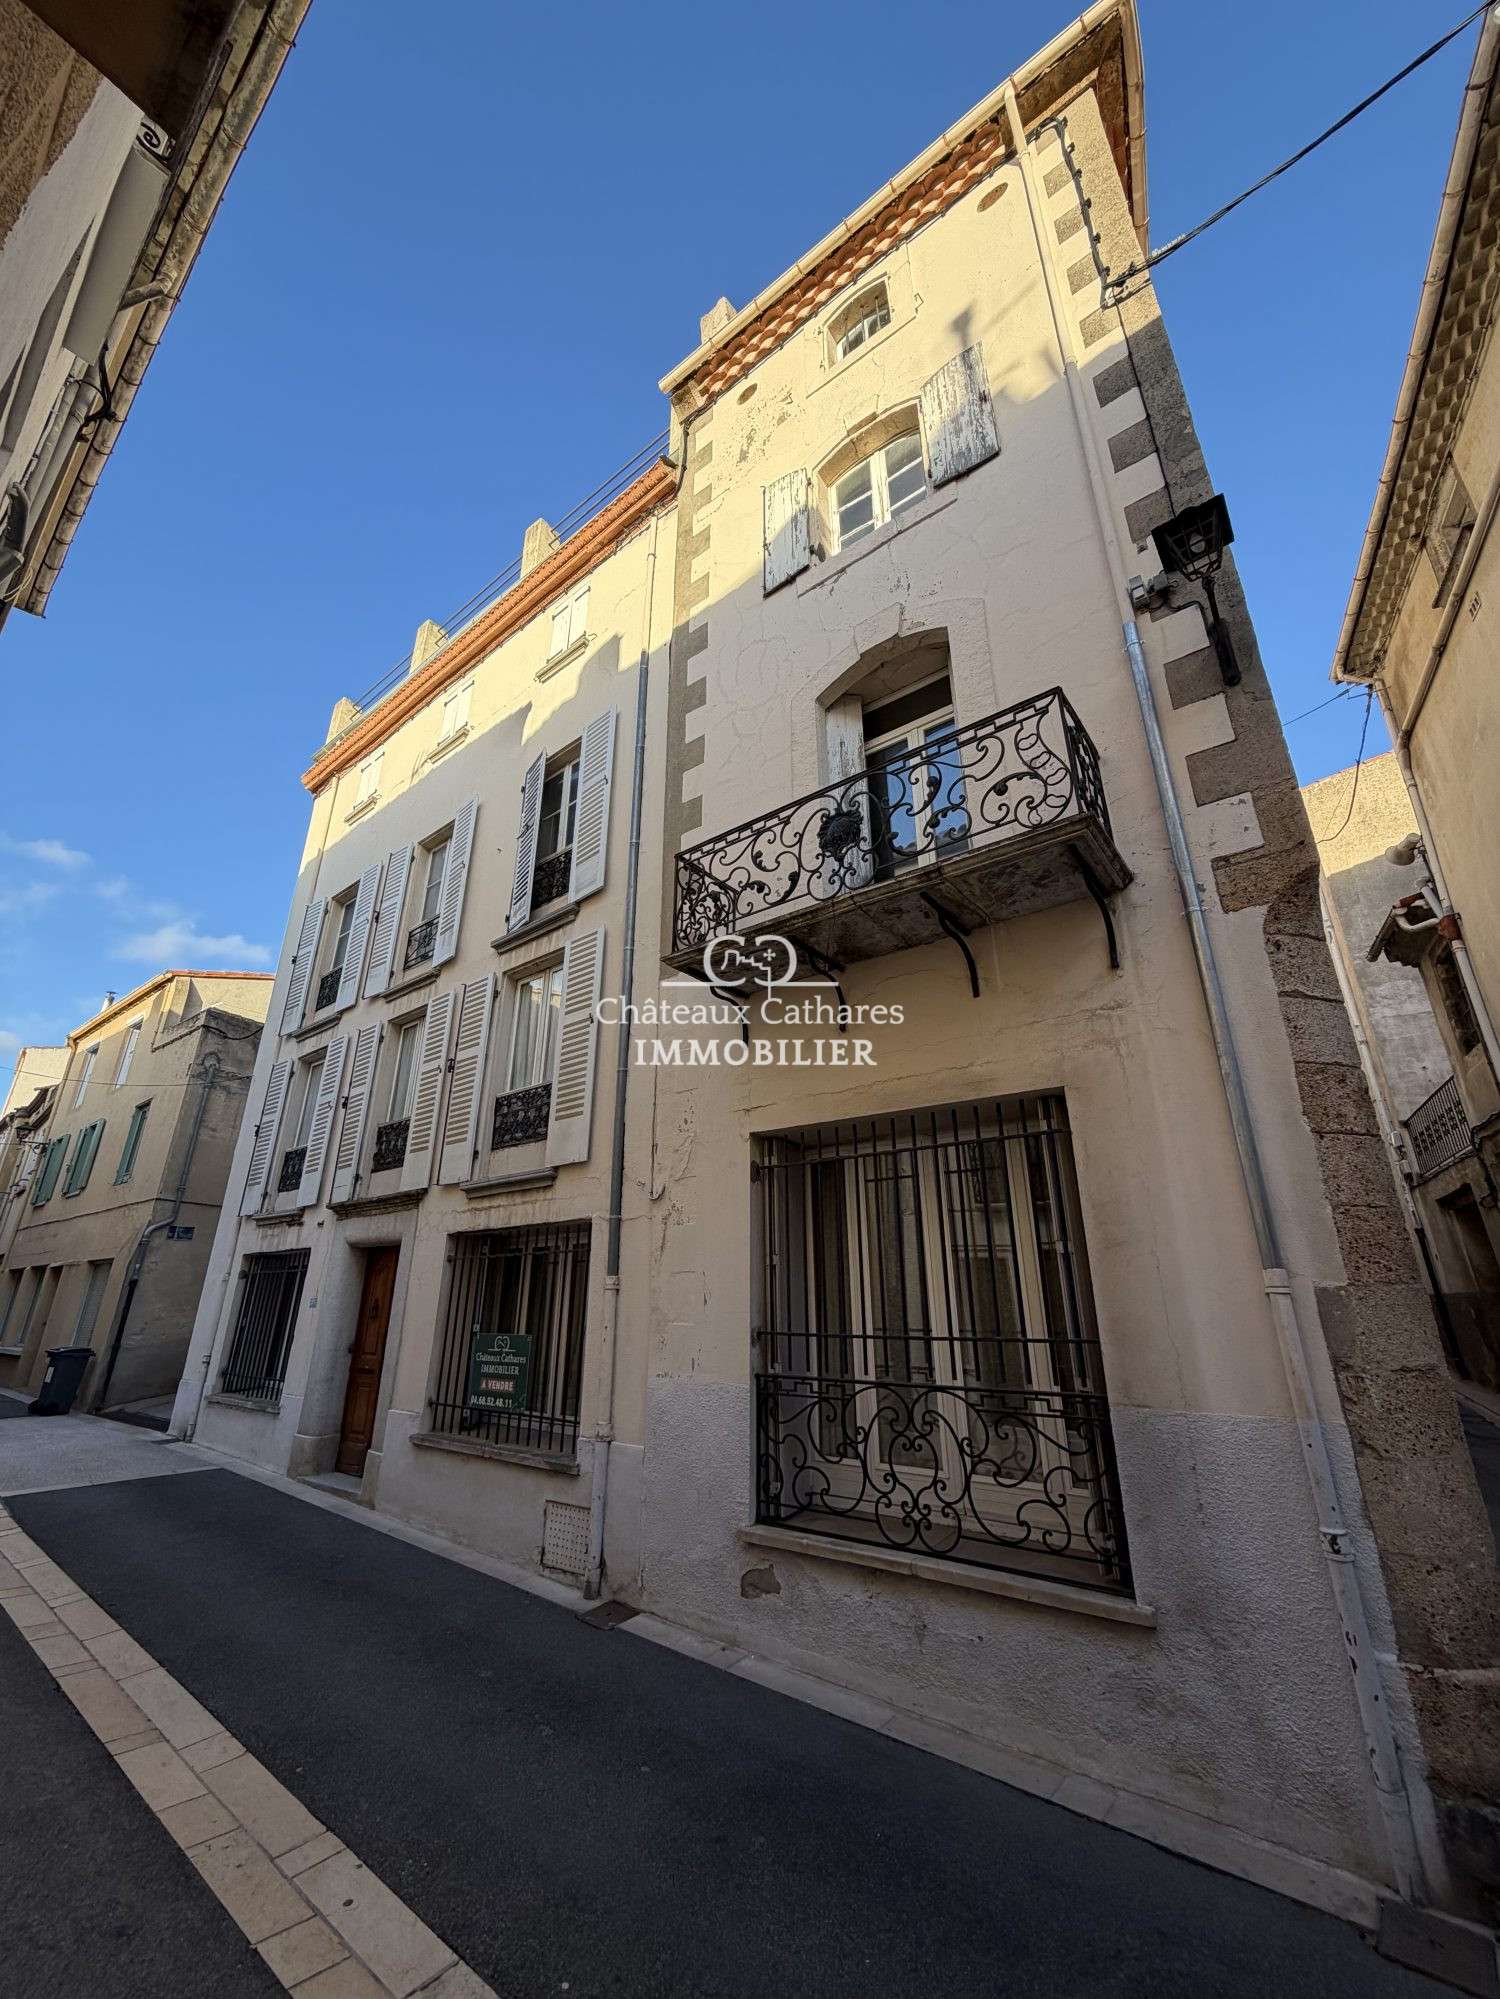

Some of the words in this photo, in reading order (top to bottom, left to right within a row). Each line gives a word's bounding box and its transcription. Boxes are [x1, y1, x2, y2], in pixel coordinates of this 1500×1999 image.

[501, 1353, 526, 1363] Cathares
[481, 1365, 519, 1375] IMMOBILIER
[488, 1380, 513, 1391] VENDRE
